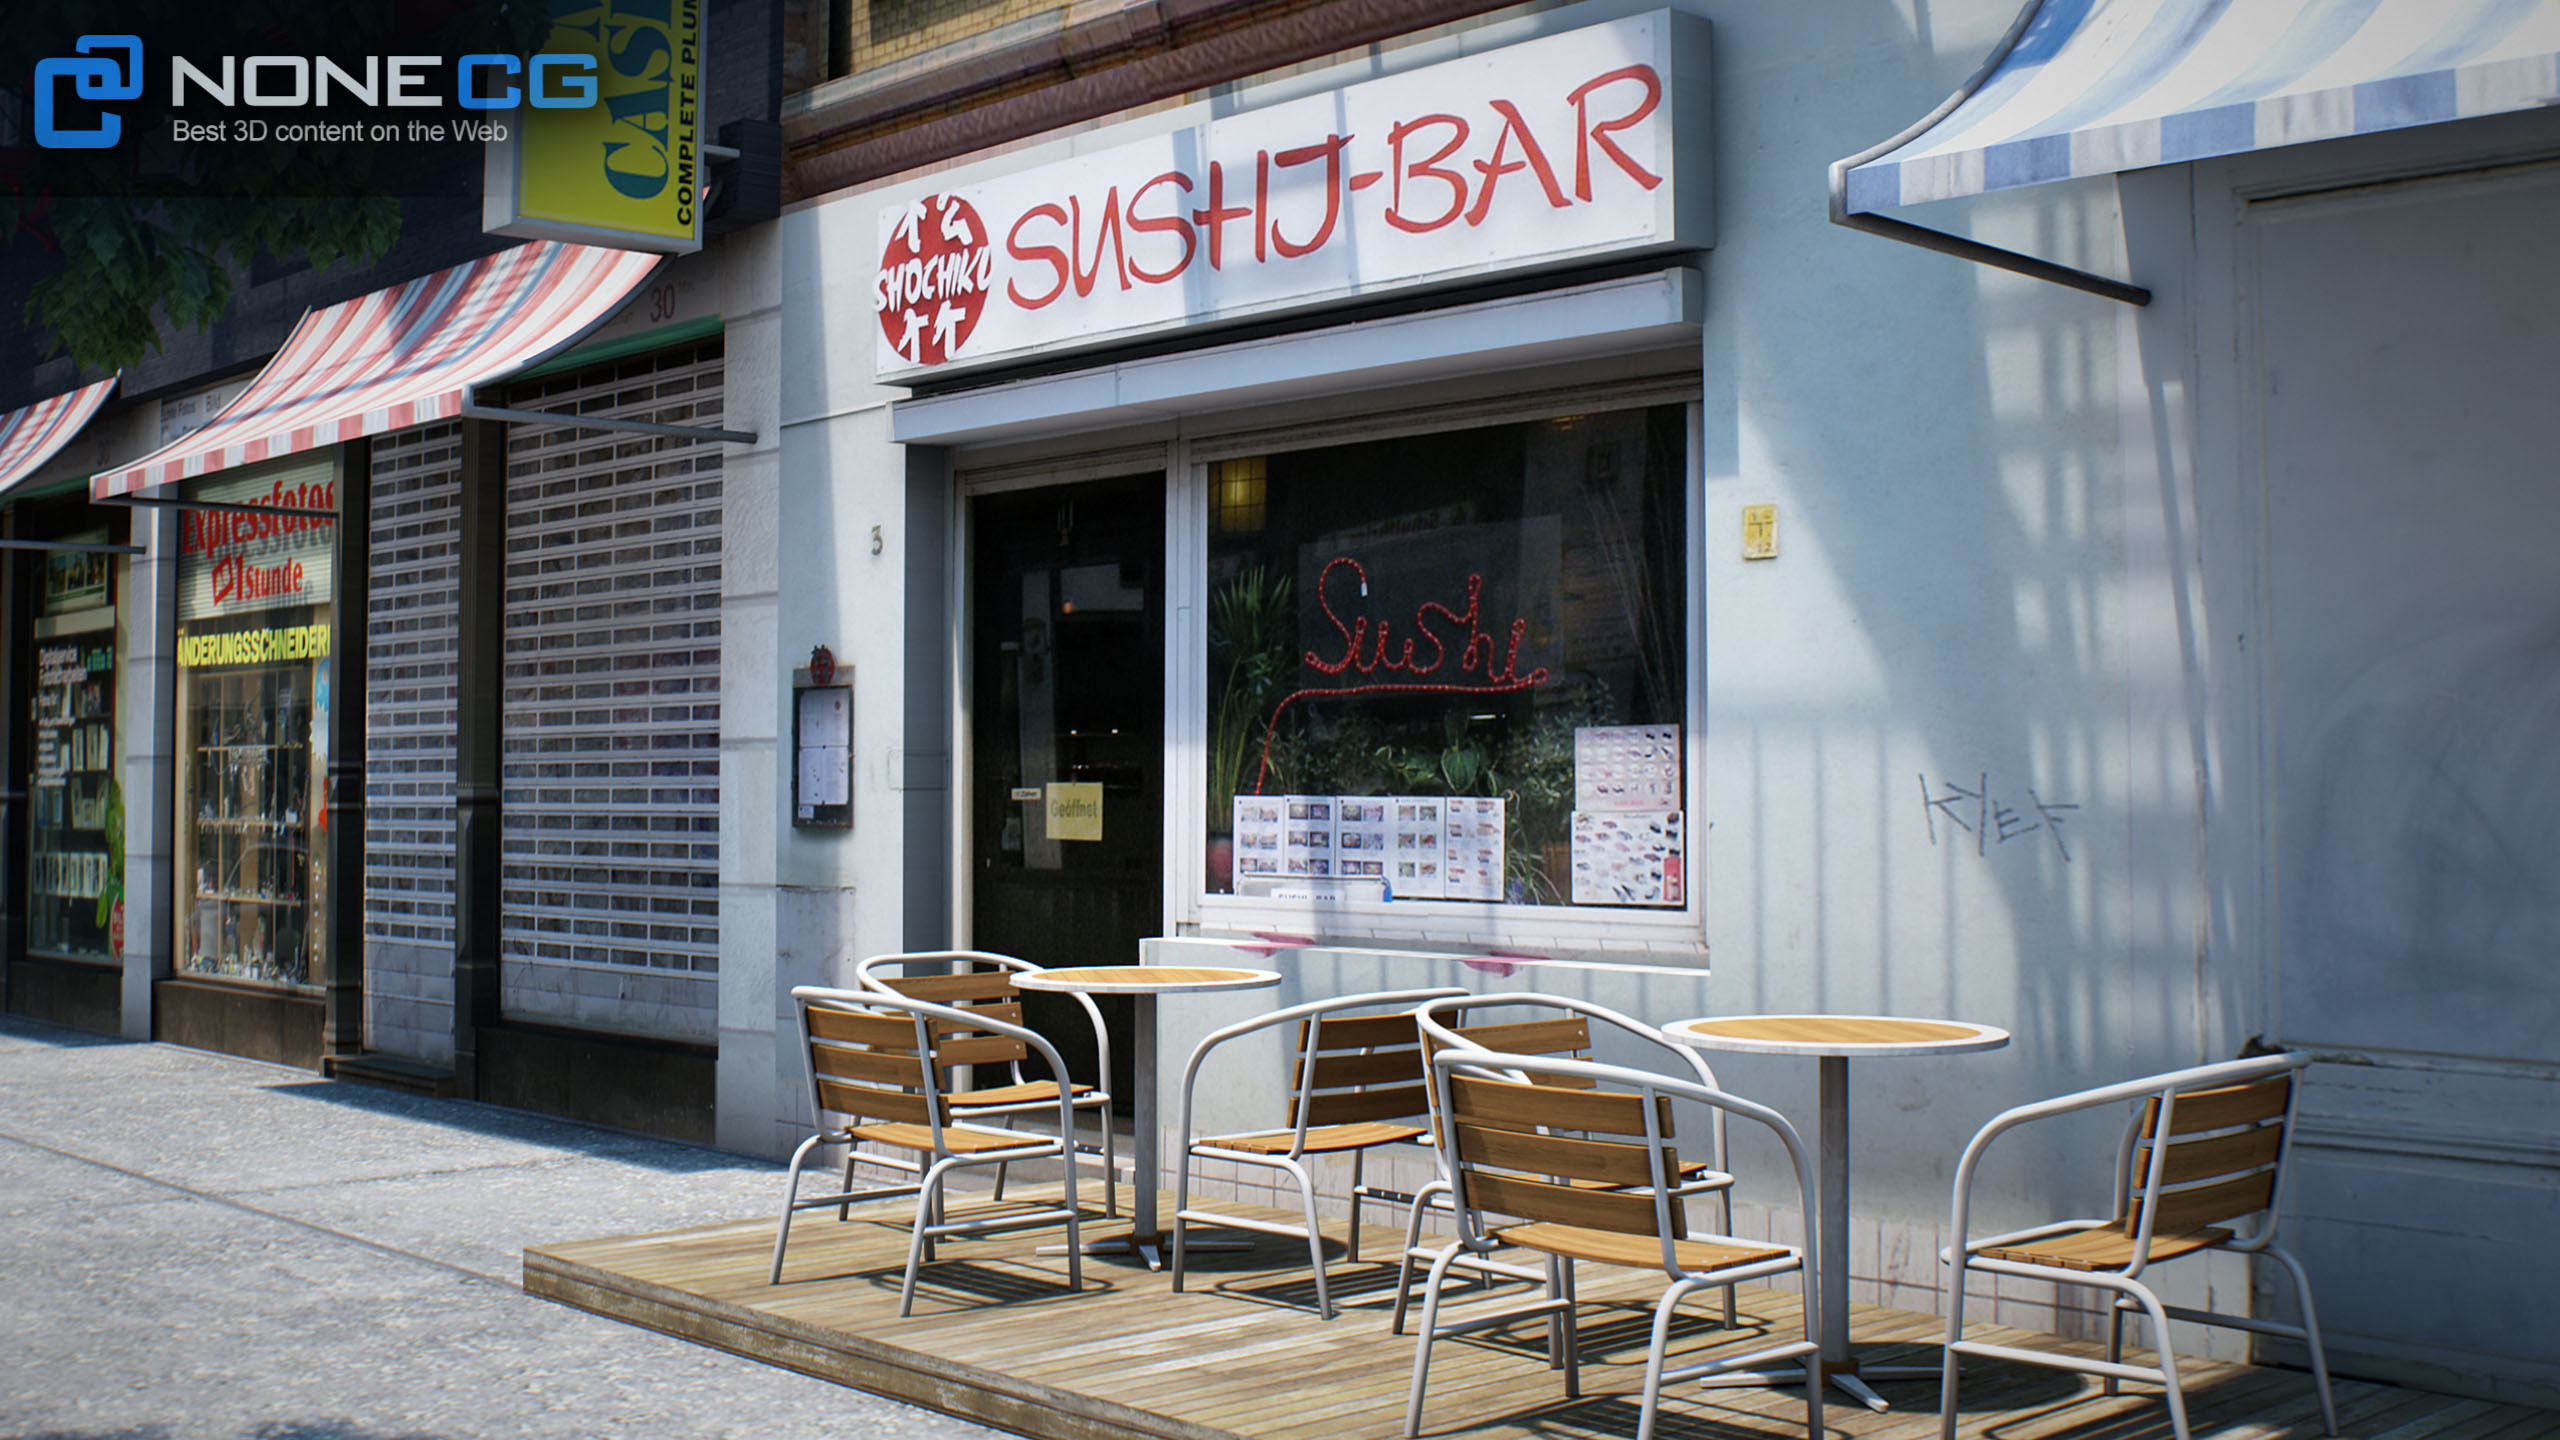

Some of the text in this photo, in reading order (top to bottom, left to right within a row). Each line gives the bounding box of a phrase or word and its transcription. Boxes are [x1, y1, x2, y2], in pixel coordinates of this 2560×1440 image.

[677, 73, 696, 226] COMPLETE
[649, 283, 676, 323] 30
[871, 524, 884, 556] 3
[234, 552, 244, 601] 1
[1305, 557, 1549, 685] Sushi
